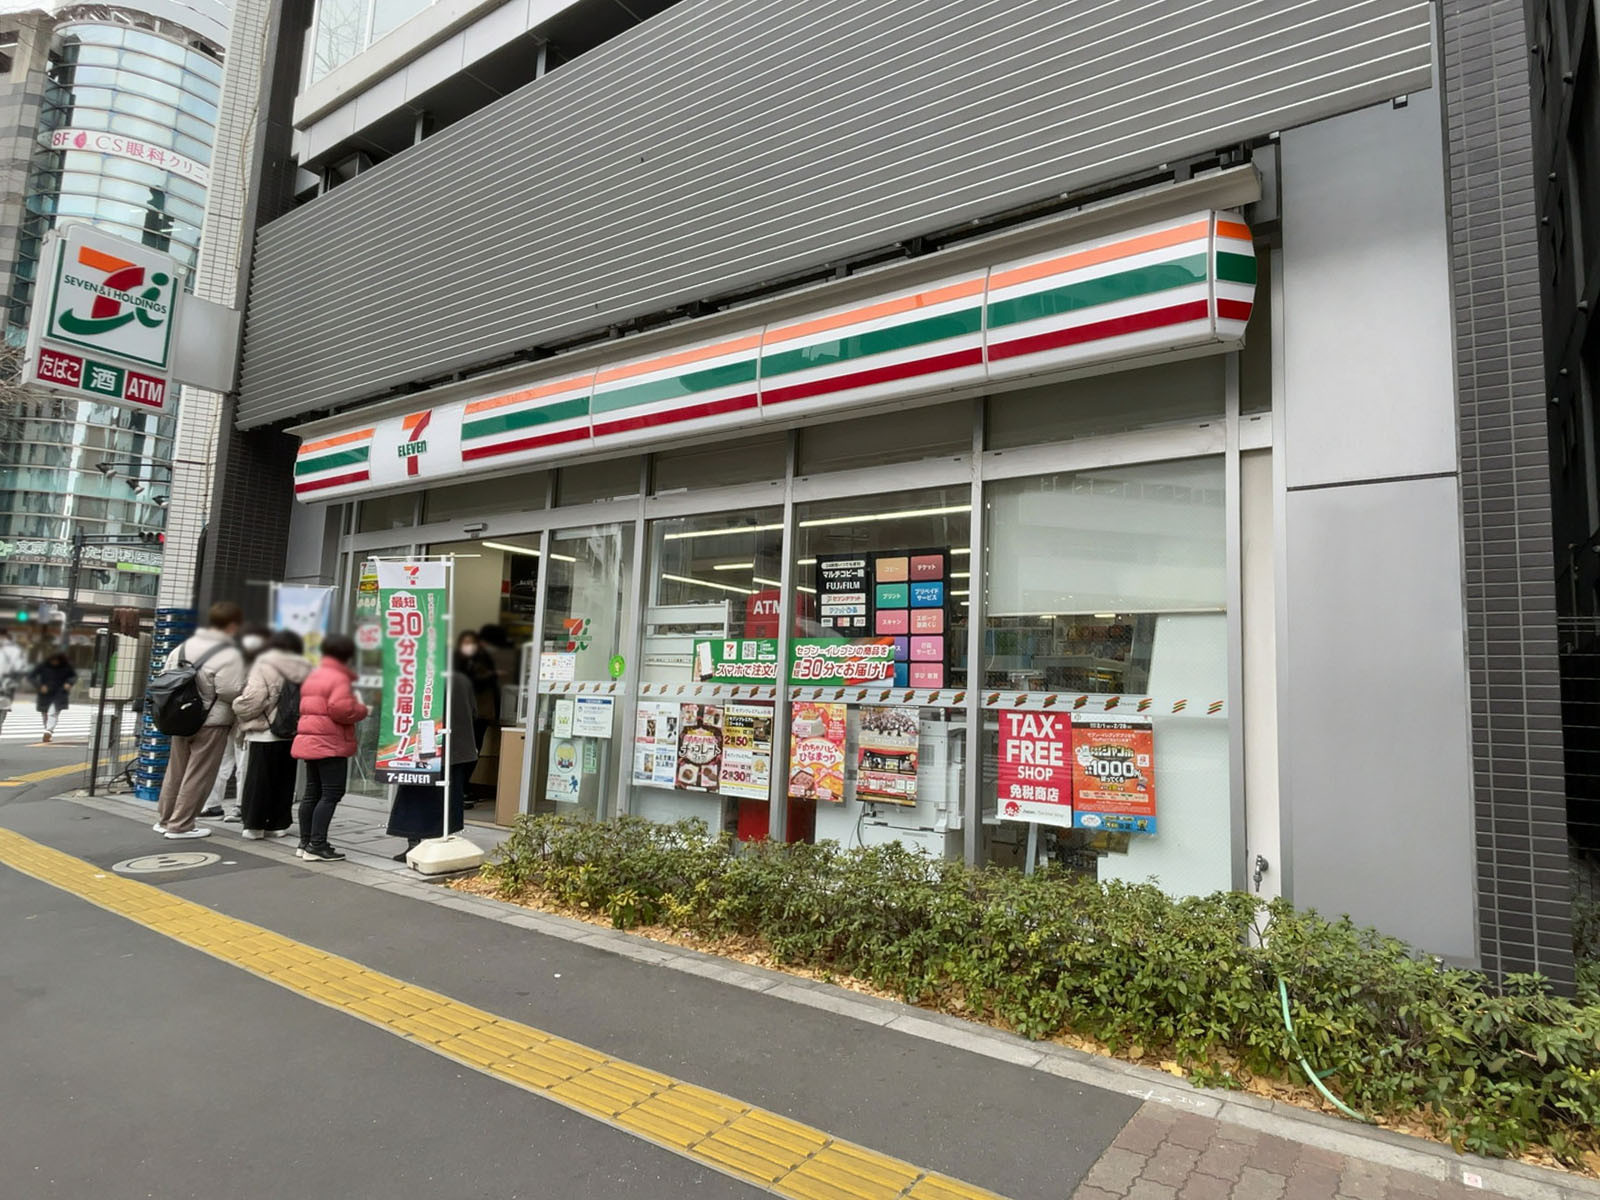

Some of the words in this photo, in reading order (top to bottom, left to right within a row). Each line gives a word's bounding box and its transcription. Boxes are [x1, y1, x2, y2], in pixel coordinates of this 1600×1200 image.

[52, 131, 70, 147] 8F
[94, 136, 208, 181] CS眼科クリニ
[113, 290, 168, 315] HOLDINGS
[38, 353, 80, 383] たばこ
[90, 366, 118, 392] 酒
[127, 377, 164, 404] ATM
[387, 612, 423, 638] 30
[799, 752, 837, 765] ひなまつり
[1006, 739, 1064, 767] FREE
[1017, 765, 1054, 781] SHOP
[1009, 783, 1060, 803] 免税商店
